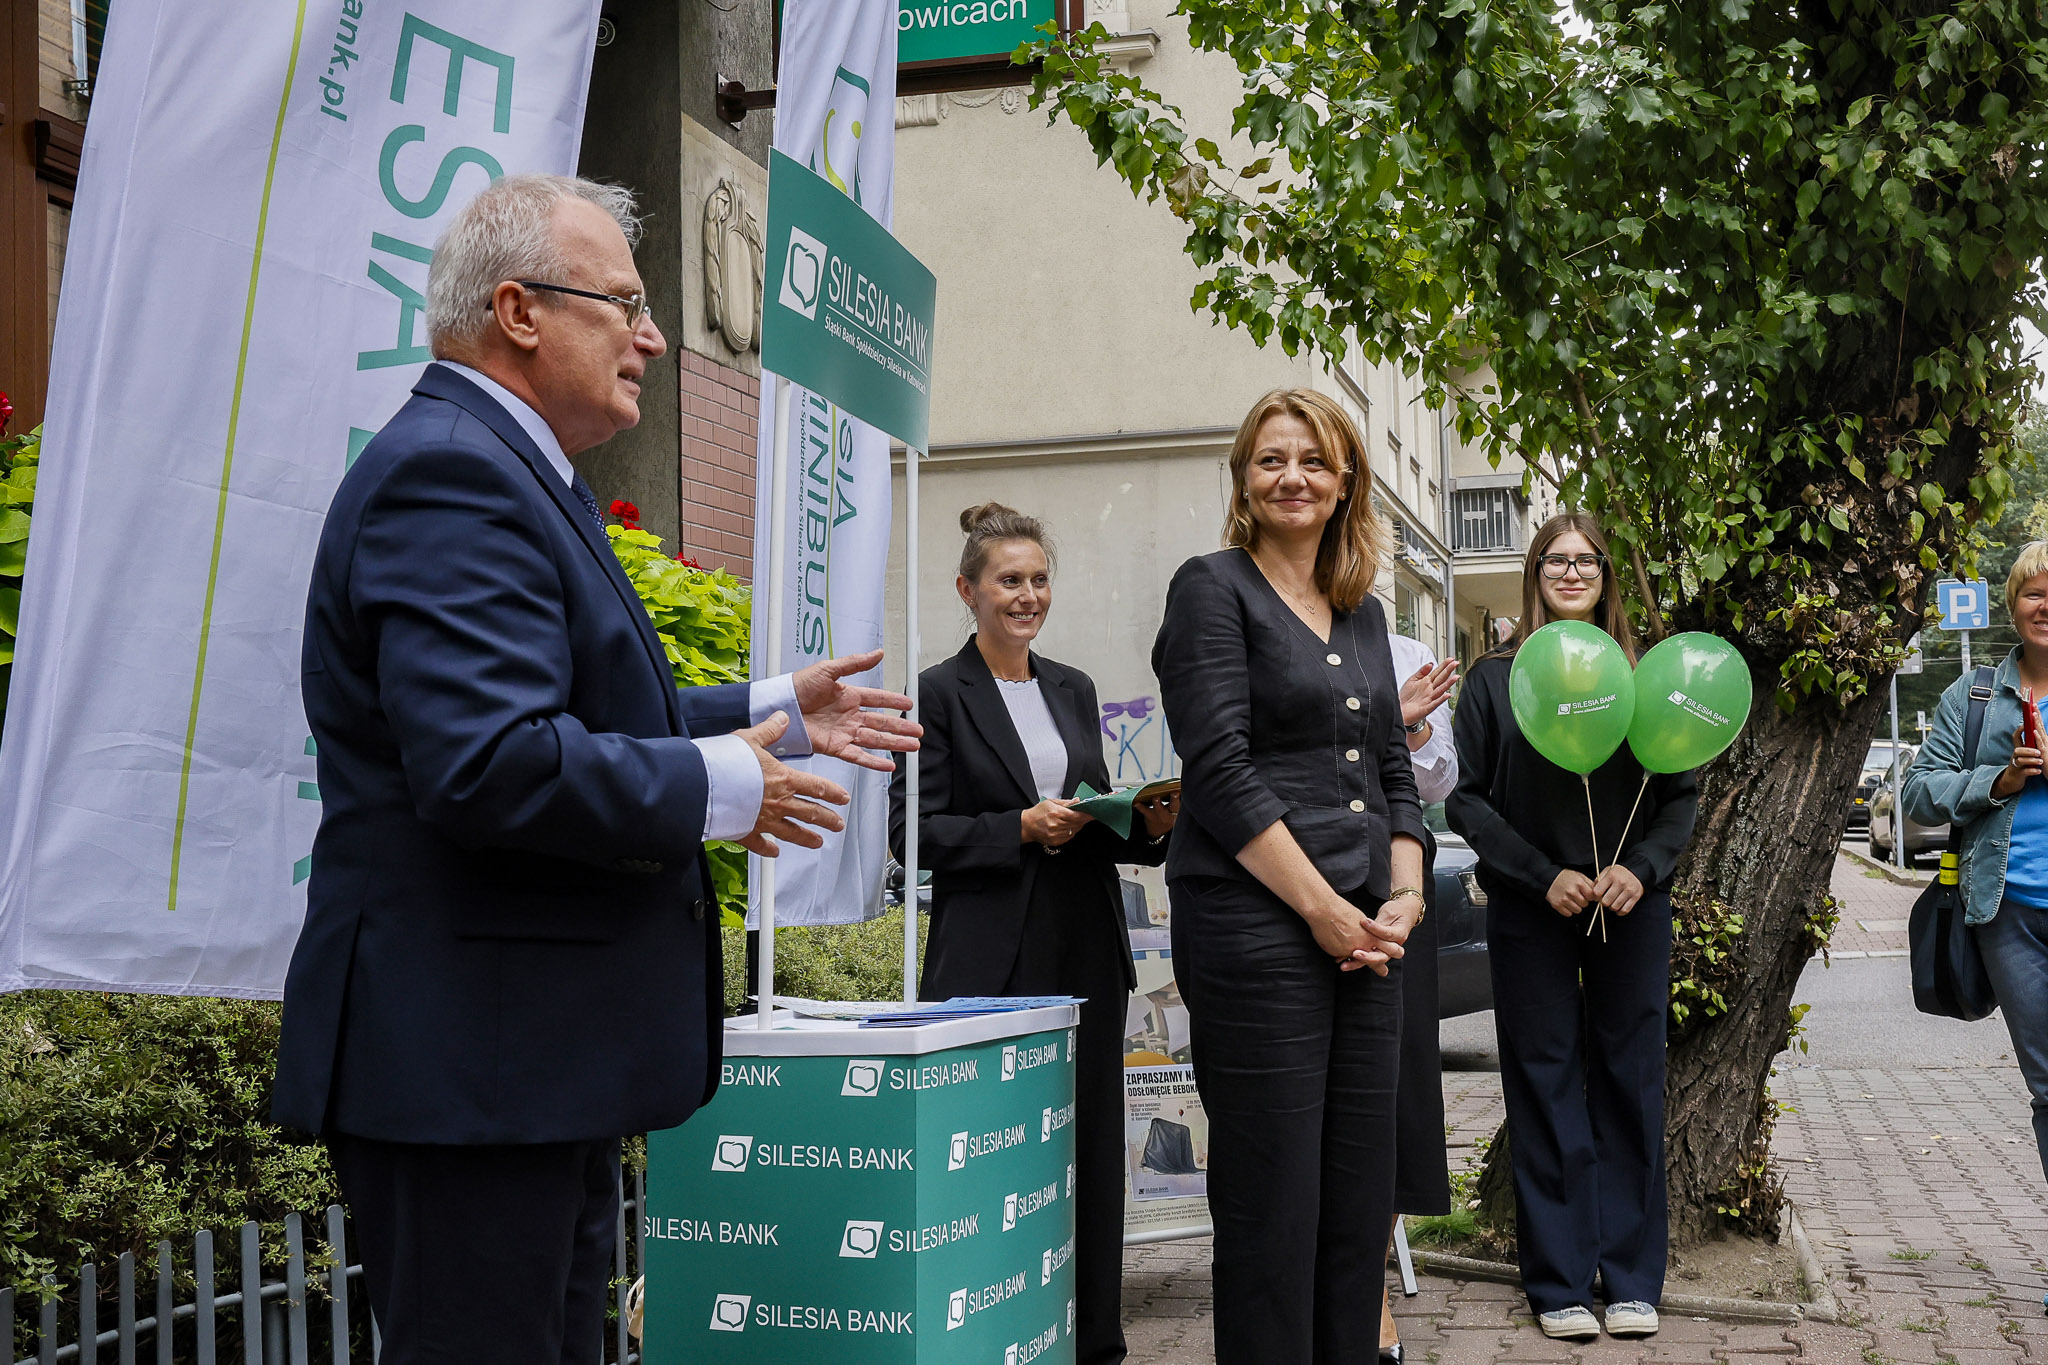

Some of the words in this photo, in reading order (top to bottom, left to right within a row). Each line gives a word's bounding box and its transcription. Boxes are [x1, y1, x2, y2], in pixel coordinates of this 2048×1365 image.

[898, 0, 1027, 31] owicach
[319, 0, 363, 121] ank.pl
[828, 255, 890, 340] SILESIA
[894, 302, 928, 369] BANK
[824, 313, 842, 337] Śląski
[842, 326, 855, 348] Bank
[855, 337, 887, 369] Spółdzielczy
[887, 356, 902, 377] Silesia
[798, 410, 807, 512] Spółdzielczego
[832, 417, 858, 529] SIA
[797, 513, 805, 557] Silesia
[797, 561, 803, 573] w
[1949, 587, 1977, 624] P
[1572, 699, 1599, 709] SILESIA
[1599, 694, 1616, 704] BANK
[1685, 698, 1713, 718] SILESIA
[1712, 711, 1730, 726] BANK
[1017, 1047, 1042, 1071] SILESIA
[1043, 1042, 1058, 1066] BANK
[721, 1065, 782, 1087] BANK
[889, 1065, 950, 1090] SILESIA
[952, 1059, 979, 1083] BANK
[1126, 1071, 1182, 1085] ZAPRASZAMY
[1127, 1085, 1171, 1098] ODSŁONIĘCIE
[969, 1130, 1003, 1158] SILESIA
[1005, 1123, 1026, 1149] BANK
[757, 1144, 842, 1169] SILESIA
[849, 1147, 914, 1171] BANK
[1018, 1190, 1042, 1218] SILESIA
[1043, 1181, 1058, 1207] BANK
[644, 1216, 713, 1242] SILESIA
[719, 1222, 779, 1246] BANK
[888, 1224, 949, 1252] SILESIA
[951, 1213, 979, 1242] BANK
[968, 1282, 1004, 1315] SILESIA
[1005, 1270, 1027, 1300] BANK
[755, 1304, 841, 1331] SILESIA
[848, 1309, 913, 1334] BANK
[1018, 1334, 1043, 1365] SILESIA
[1043, 1322, 1058, 1351] BANK
